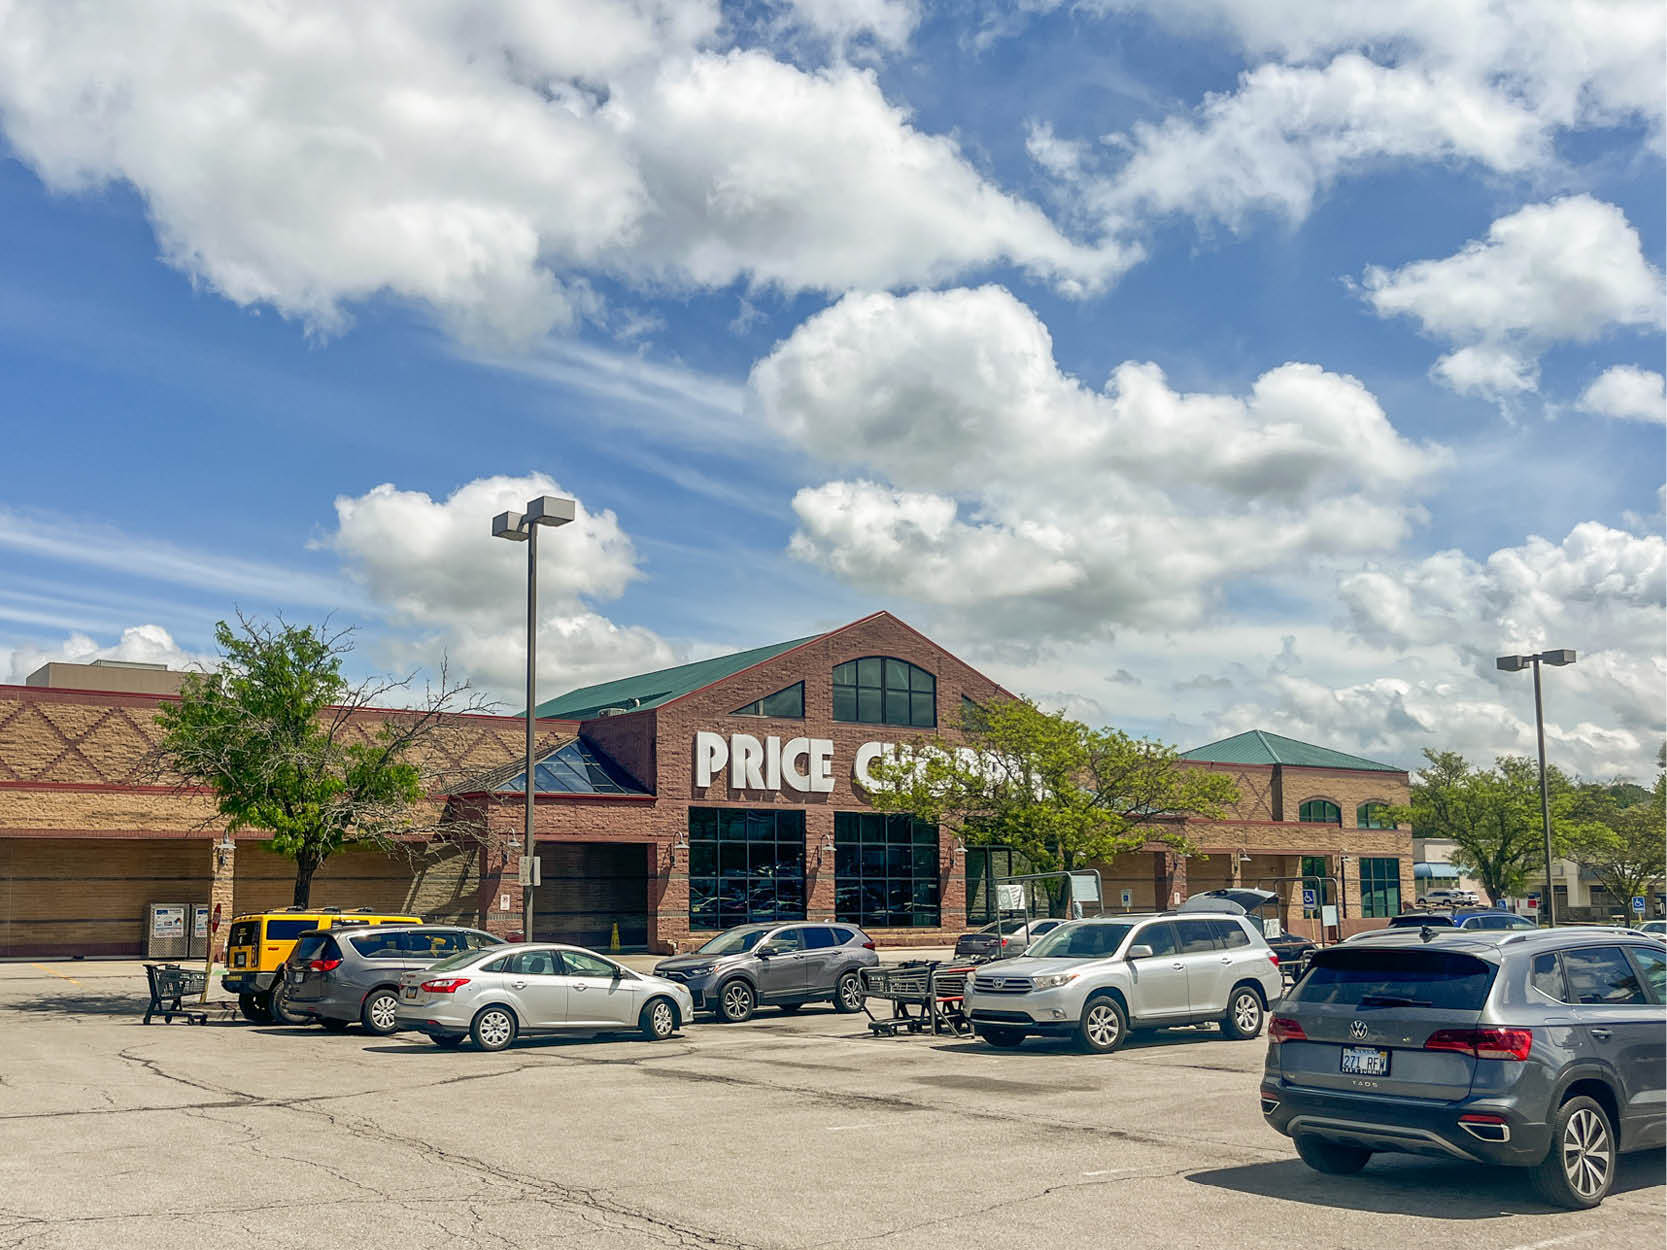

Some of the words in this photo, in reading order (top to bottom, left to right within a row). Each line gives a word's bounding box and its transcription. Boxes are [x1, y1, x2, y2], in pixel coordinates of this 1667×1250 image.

[696, 731, 835, 793] PRICE
[1344, 1055, 1360, 1069] 271
[1352, 1080, 1378, 1088] TAOS
